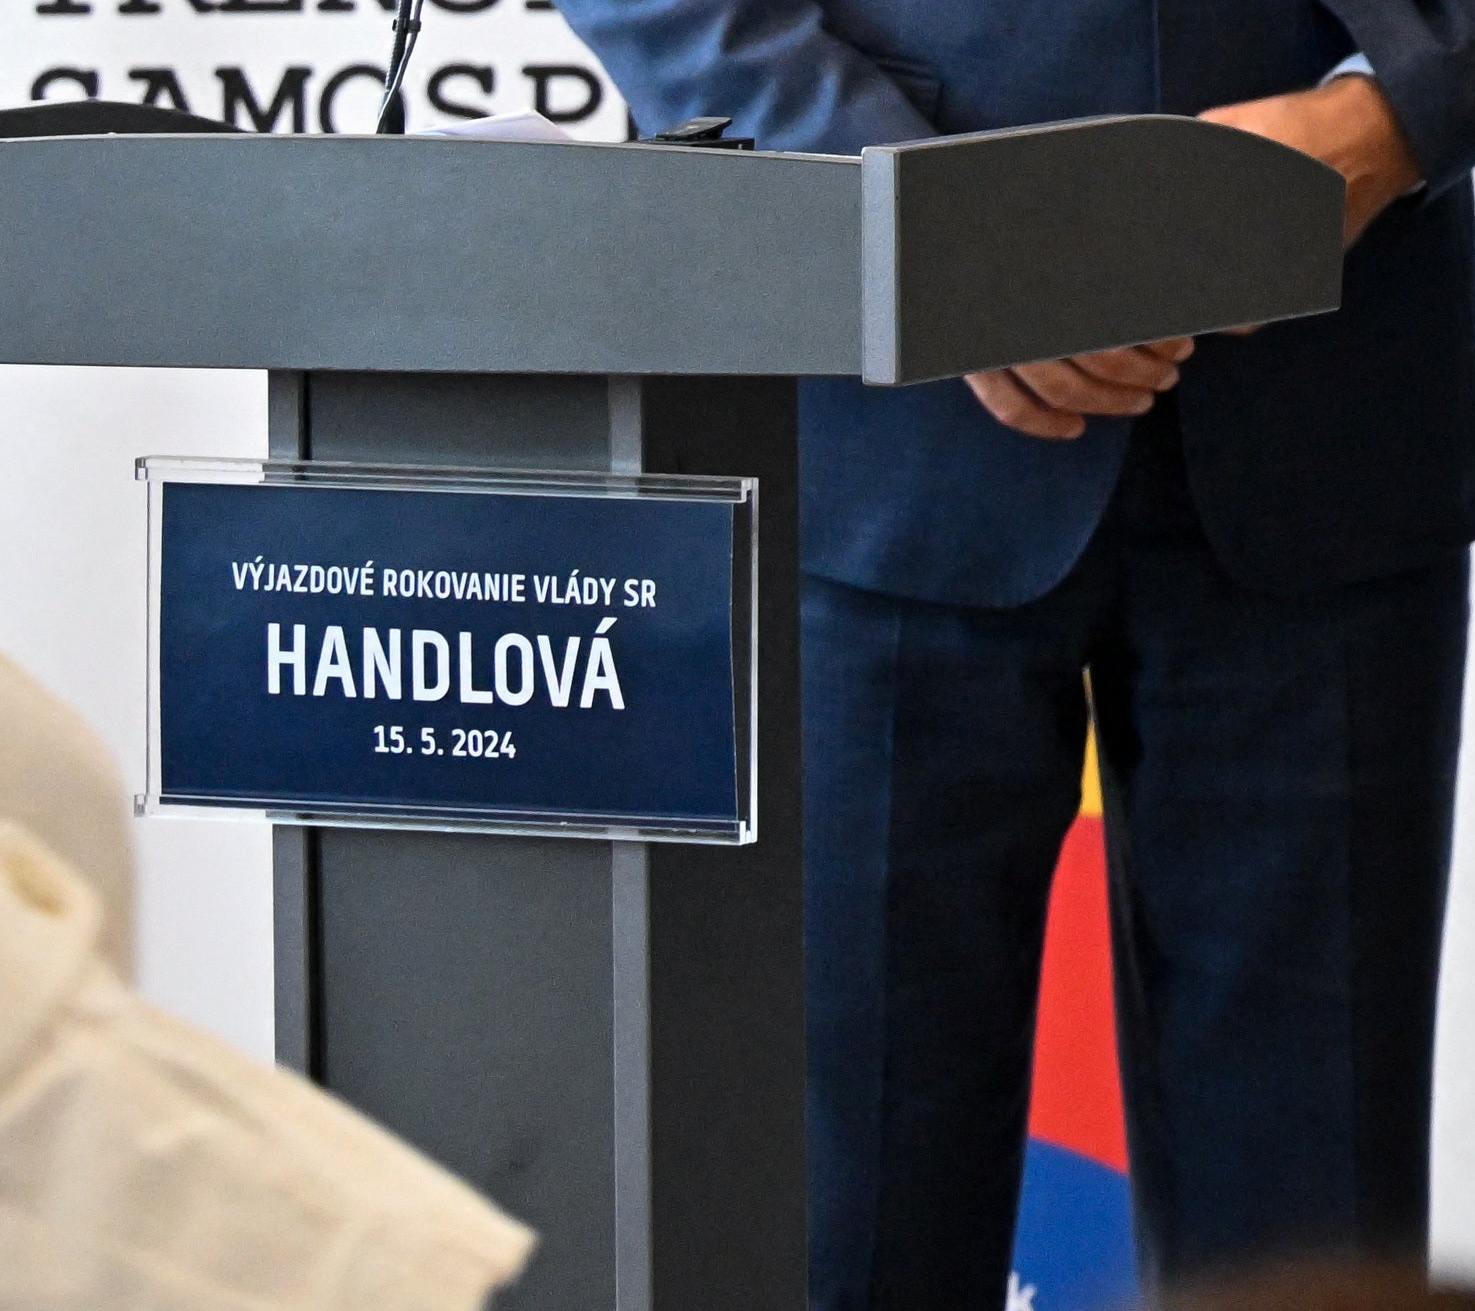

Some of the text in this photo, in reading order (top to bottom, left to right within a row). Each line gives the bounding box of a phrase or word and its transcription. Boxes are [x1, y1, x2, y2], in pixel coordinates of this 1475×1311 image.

[232, 555, 657, 608] VÝJAZDOVÉ ROKOVANIE VLÁDY SR
[267, 616, 626, 710] HANDLOVÁ
[373, 724, 517, 759] 15. 5. 2024
